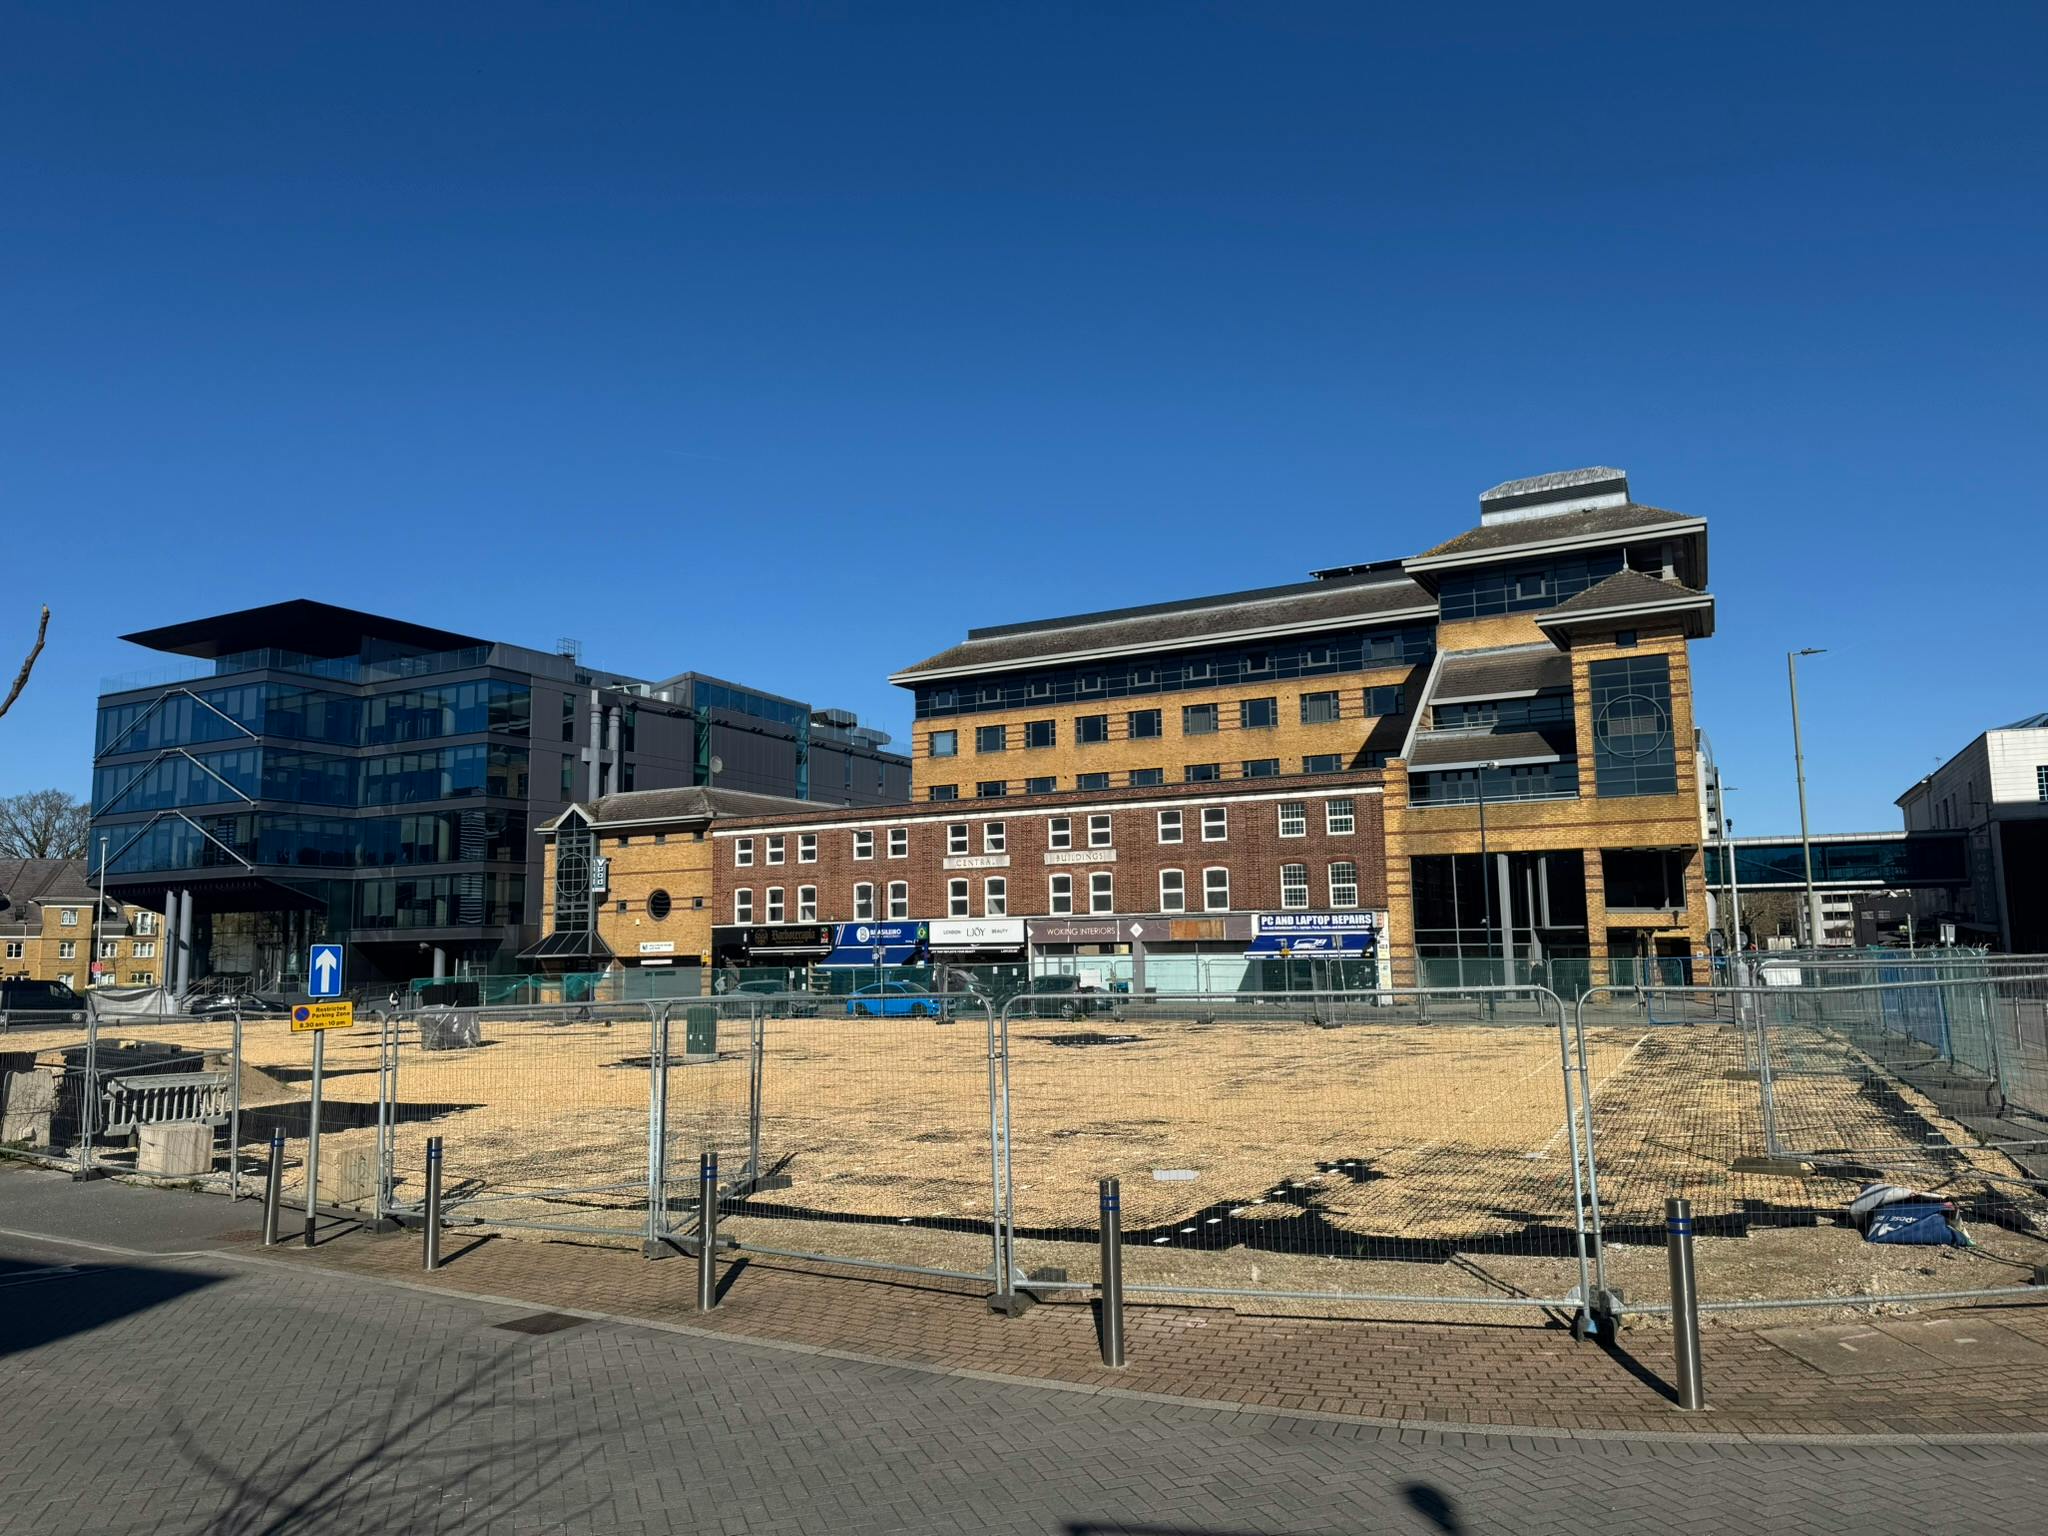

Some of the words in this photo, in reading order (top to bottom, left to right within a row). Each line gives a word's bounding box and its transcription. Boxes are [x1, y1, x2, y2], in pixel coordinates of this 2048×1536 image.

[1055, 852, 1104, 862] BUILDINGS
[1261, 915, 1274, 926] PC
[1275, 915, 1294, 926] AND
[1295, 915, 1331, 925] LAPTOP
[1332, 914, 1372, 925] REPAIRS
[1046, 927, 1078, 936] WOKING
[1080, 926, 1116, 936] INTERIORS
